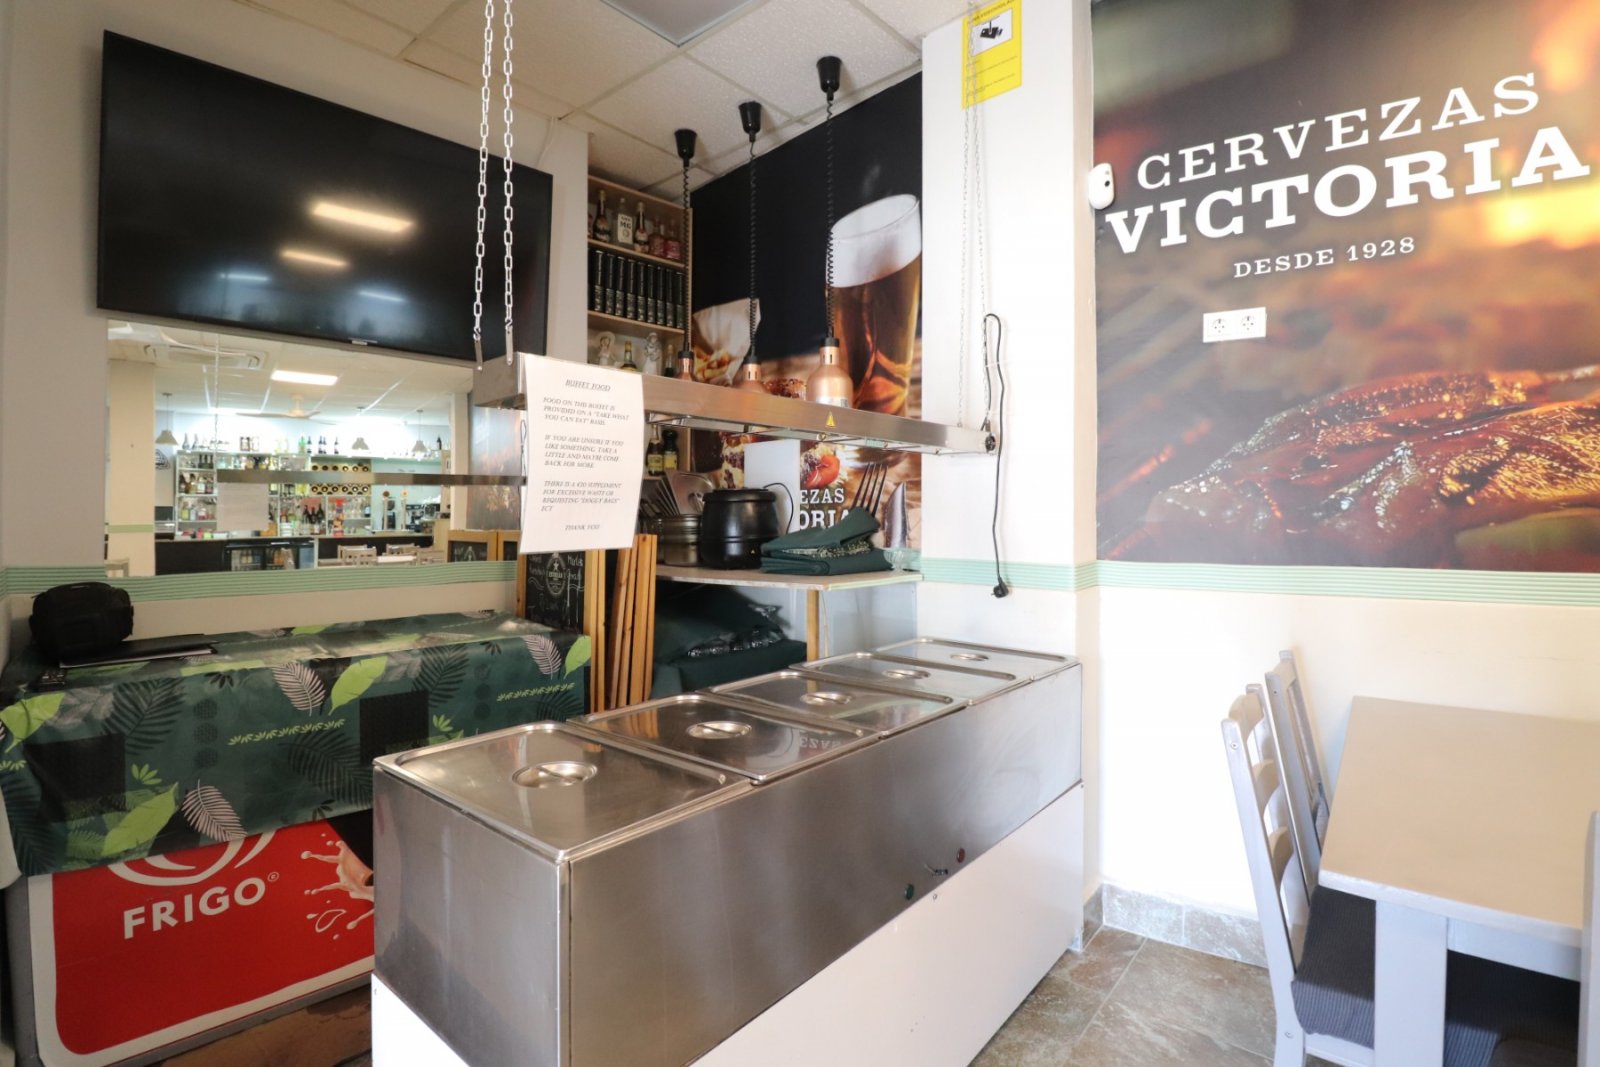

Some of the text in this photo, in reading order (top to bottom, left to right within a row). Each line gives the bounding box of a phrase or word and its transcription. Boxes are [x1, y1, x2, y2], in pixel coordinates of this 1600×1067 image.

[1137, 72, 1539, 190] CERVEZAS
[1105, 126, 1591, 254] VICTORIA
[1233, 236, 1416, 278] DESDE 1928
[565, 379, 611, 392] BUFFET FOOD
[543, 405, 576, 414] PROVIDED
[588, 402, 608, 410] BUFFET
[581, 437, 604, 445] UNSURE
[544, 451, 566, 459] LITTLE
[603, 455, 620, 463] COME
[800, 488, 845, 504] EZAS
[123, 877, 266, 939] FRIGO
